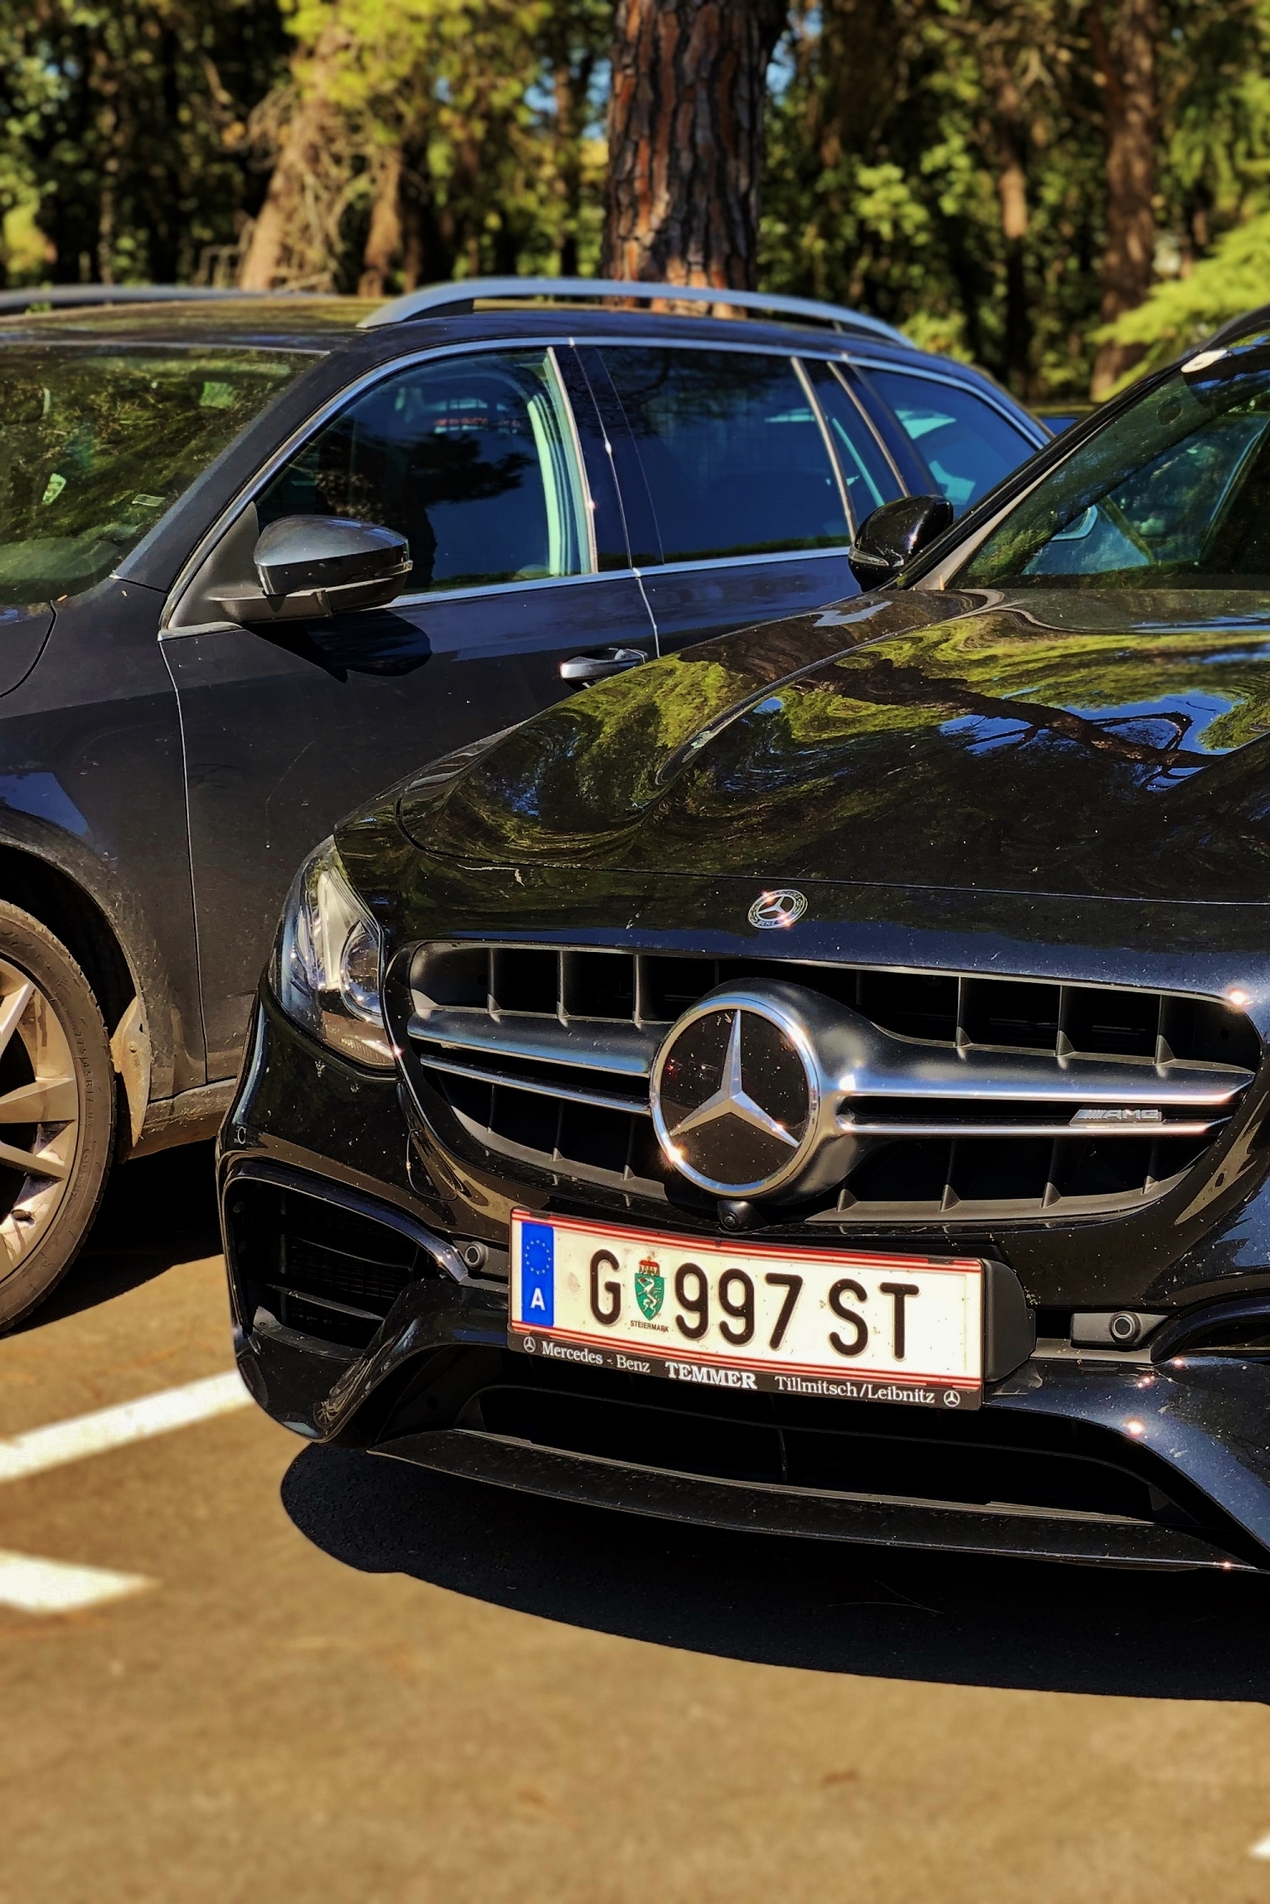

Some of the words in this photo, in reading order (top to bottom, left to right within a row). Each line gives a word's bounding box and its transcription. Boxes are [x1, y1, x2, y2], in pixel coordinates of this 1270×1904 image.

[1103, 1109, 1159, 1120] AMG
[529, 1287, 546, 1312] A
[589, 1249, 621, 1325] G
[674, 1263, 803, 1351] 997
[827, 1278, 919, 1360] ST
[630, 1319, 669, 1333] STEIERMARK
[542, 1341, 603, 1365] Mercedes
[616, 1354, 651, 1374] Benz
[665, 1361, 758, 1390] TEMMER
[774, 1376, 936, 1405] Tillmitsch/Leibnitz
